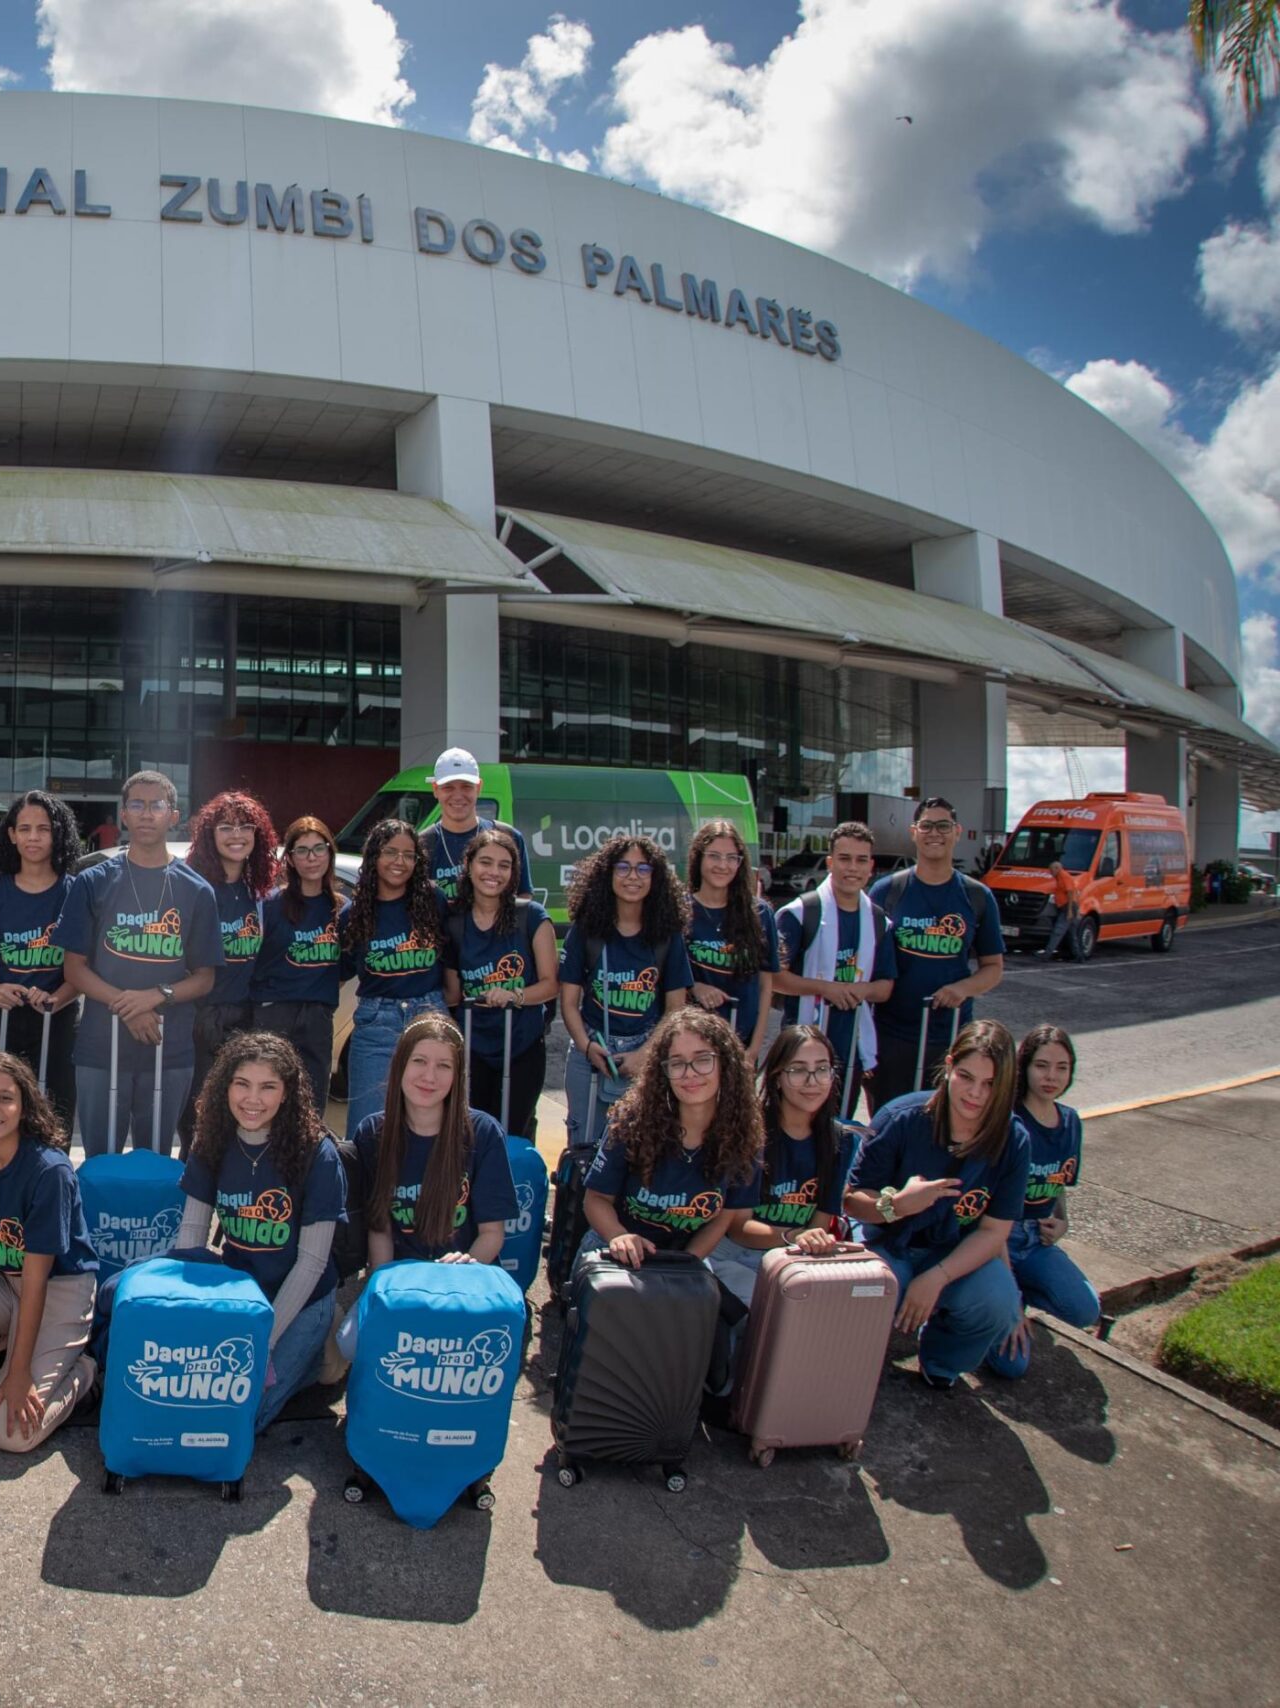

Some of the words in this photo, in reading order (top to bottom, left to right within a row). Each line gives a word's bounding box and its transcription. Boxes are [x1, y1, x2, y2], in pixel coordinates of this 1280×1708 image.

[159, 174, 374, 244] ZUMBI
[414, 206, 547, 275] DOS
[582, 244, 842, 362] PALMARES
[1033, 807, 1096, 820] movida
[116, 910, 159, 928] Daqui
[220, 916, 244, 933] Daqui
[902, 916, 937, 930] Daqui
[3, 927, 41, 943] Daqui
[295, 926, 323, 943] Daqui
[371, 932, 406, 951] Daqui
[637, 1187, 687, 1209] Daqui
[99, 1212, 147, 1232] Daqui
[397, 1331, 463, 1356] Daqui
[144, 1341, 208, 1364] Daqui
[439, 1355, 460, 1366] pra
[462, 1354, 472, 1364] O
[186, 1362, 208, 1372] pra
[210, 1360, 219, 1371] O
